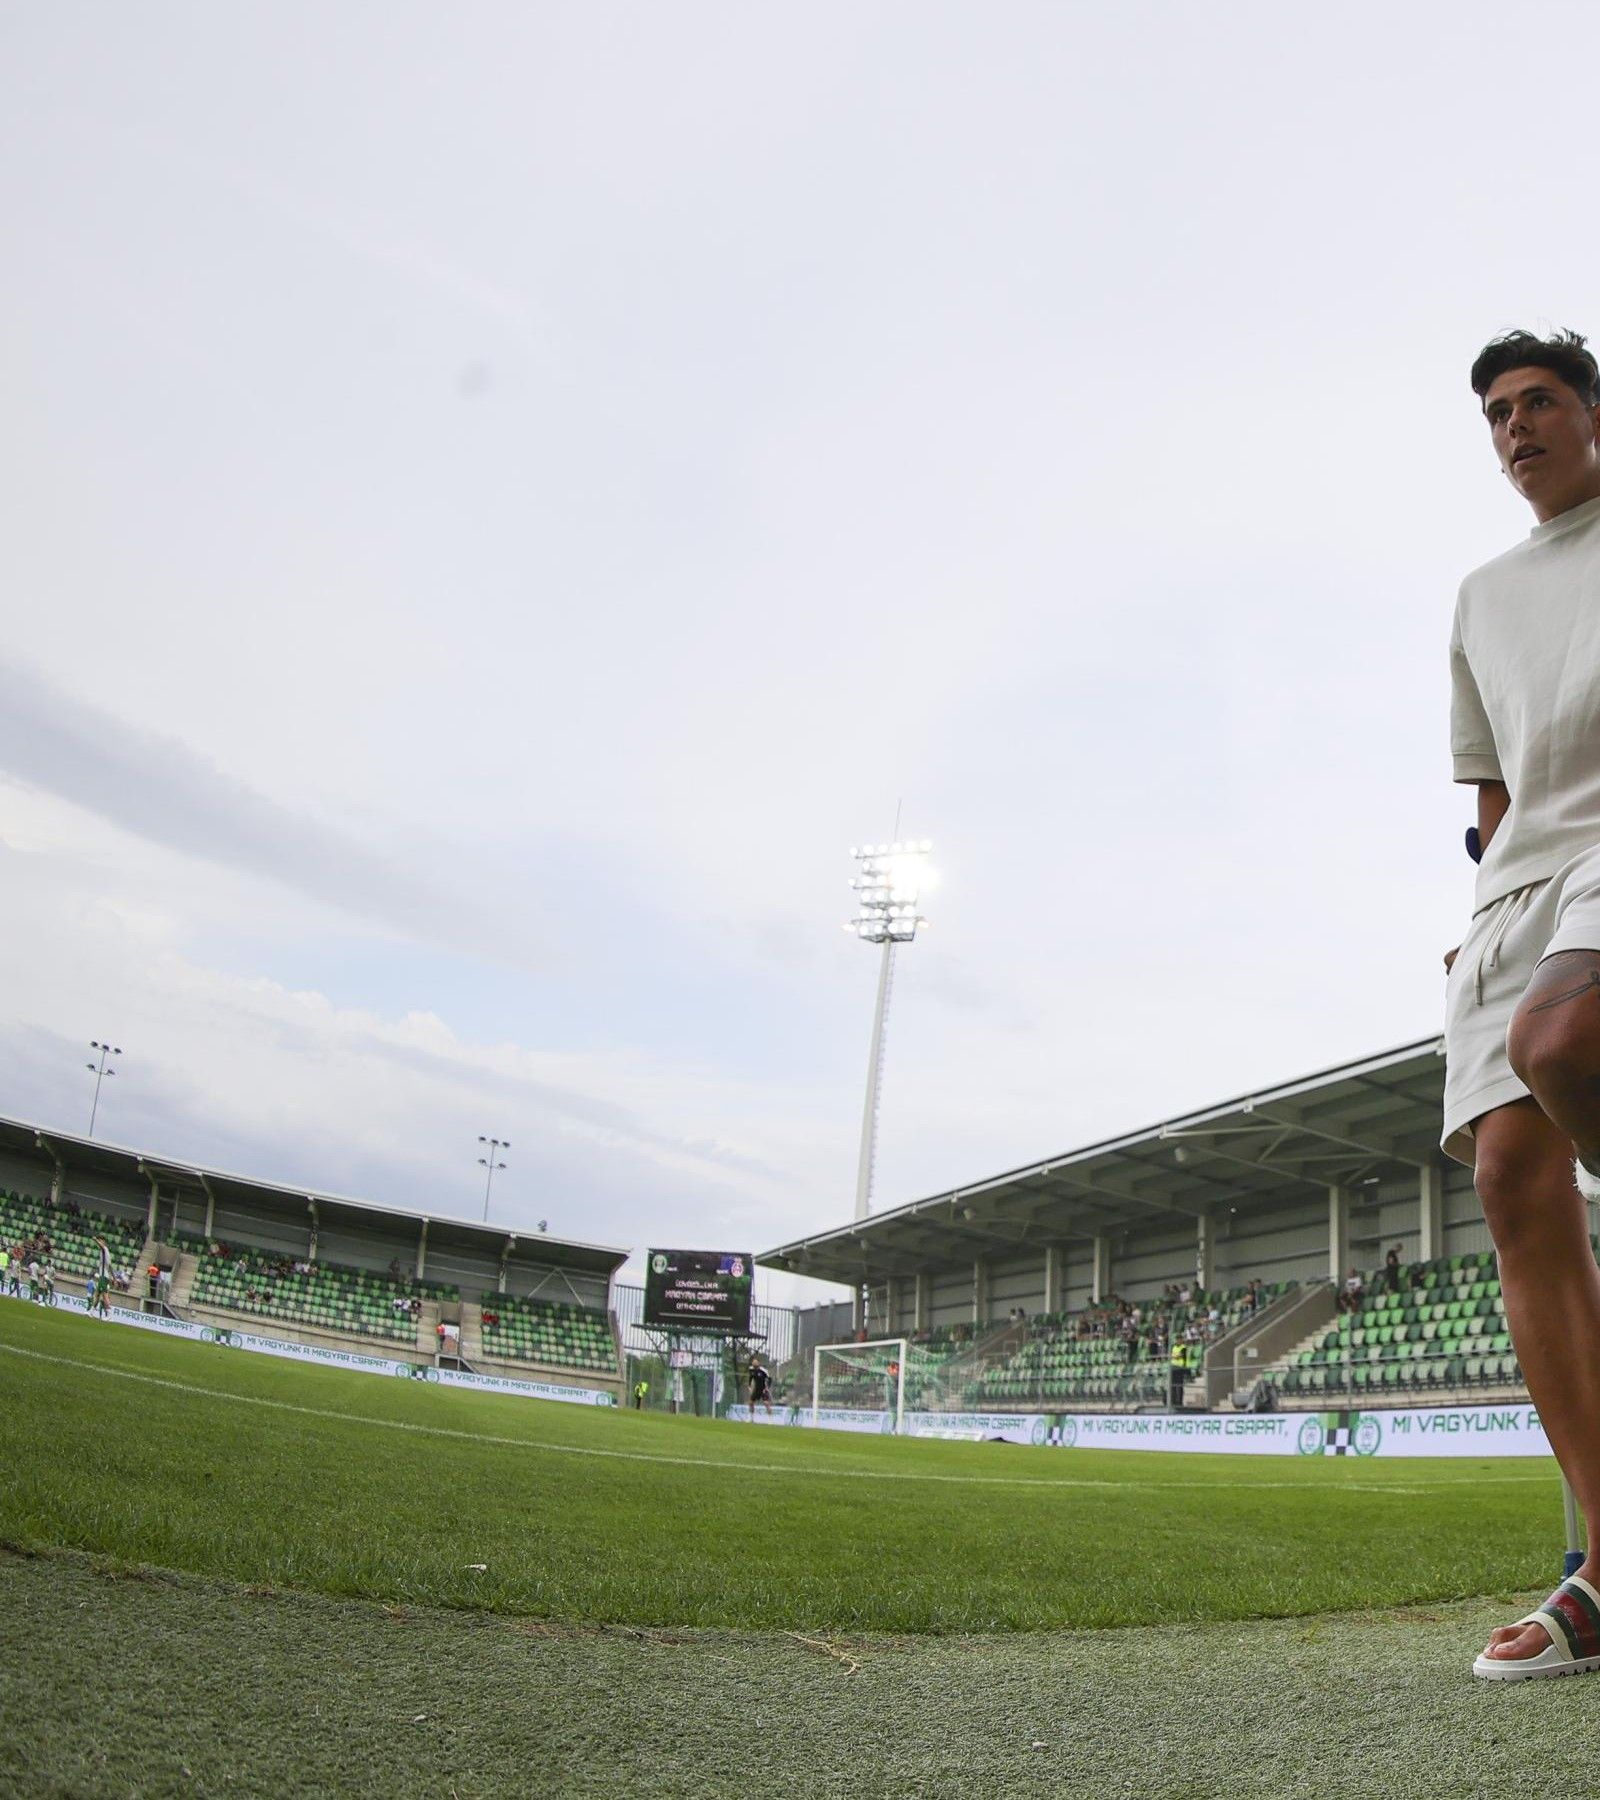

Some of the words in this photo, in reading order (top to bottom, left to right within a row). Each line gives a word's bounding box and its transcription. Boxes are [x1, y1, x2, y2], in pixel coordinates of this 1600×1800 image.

[311, 1349, 349, 1361] MAGYAR
[1083, 1420, 1093, 1432] MI
[1096, 1420, 1149, 1434] VAGYUNK
[1153, 1420, 1162, 1434] A
[1165, 1420, 1221, 1434] MAGYAR
[1225, 1419, 1288, 1437] CSAPAT,
[1392, 1415, 1411, 1433] MI
[1417, 1411, 1520, 1432] VAGYUNK
